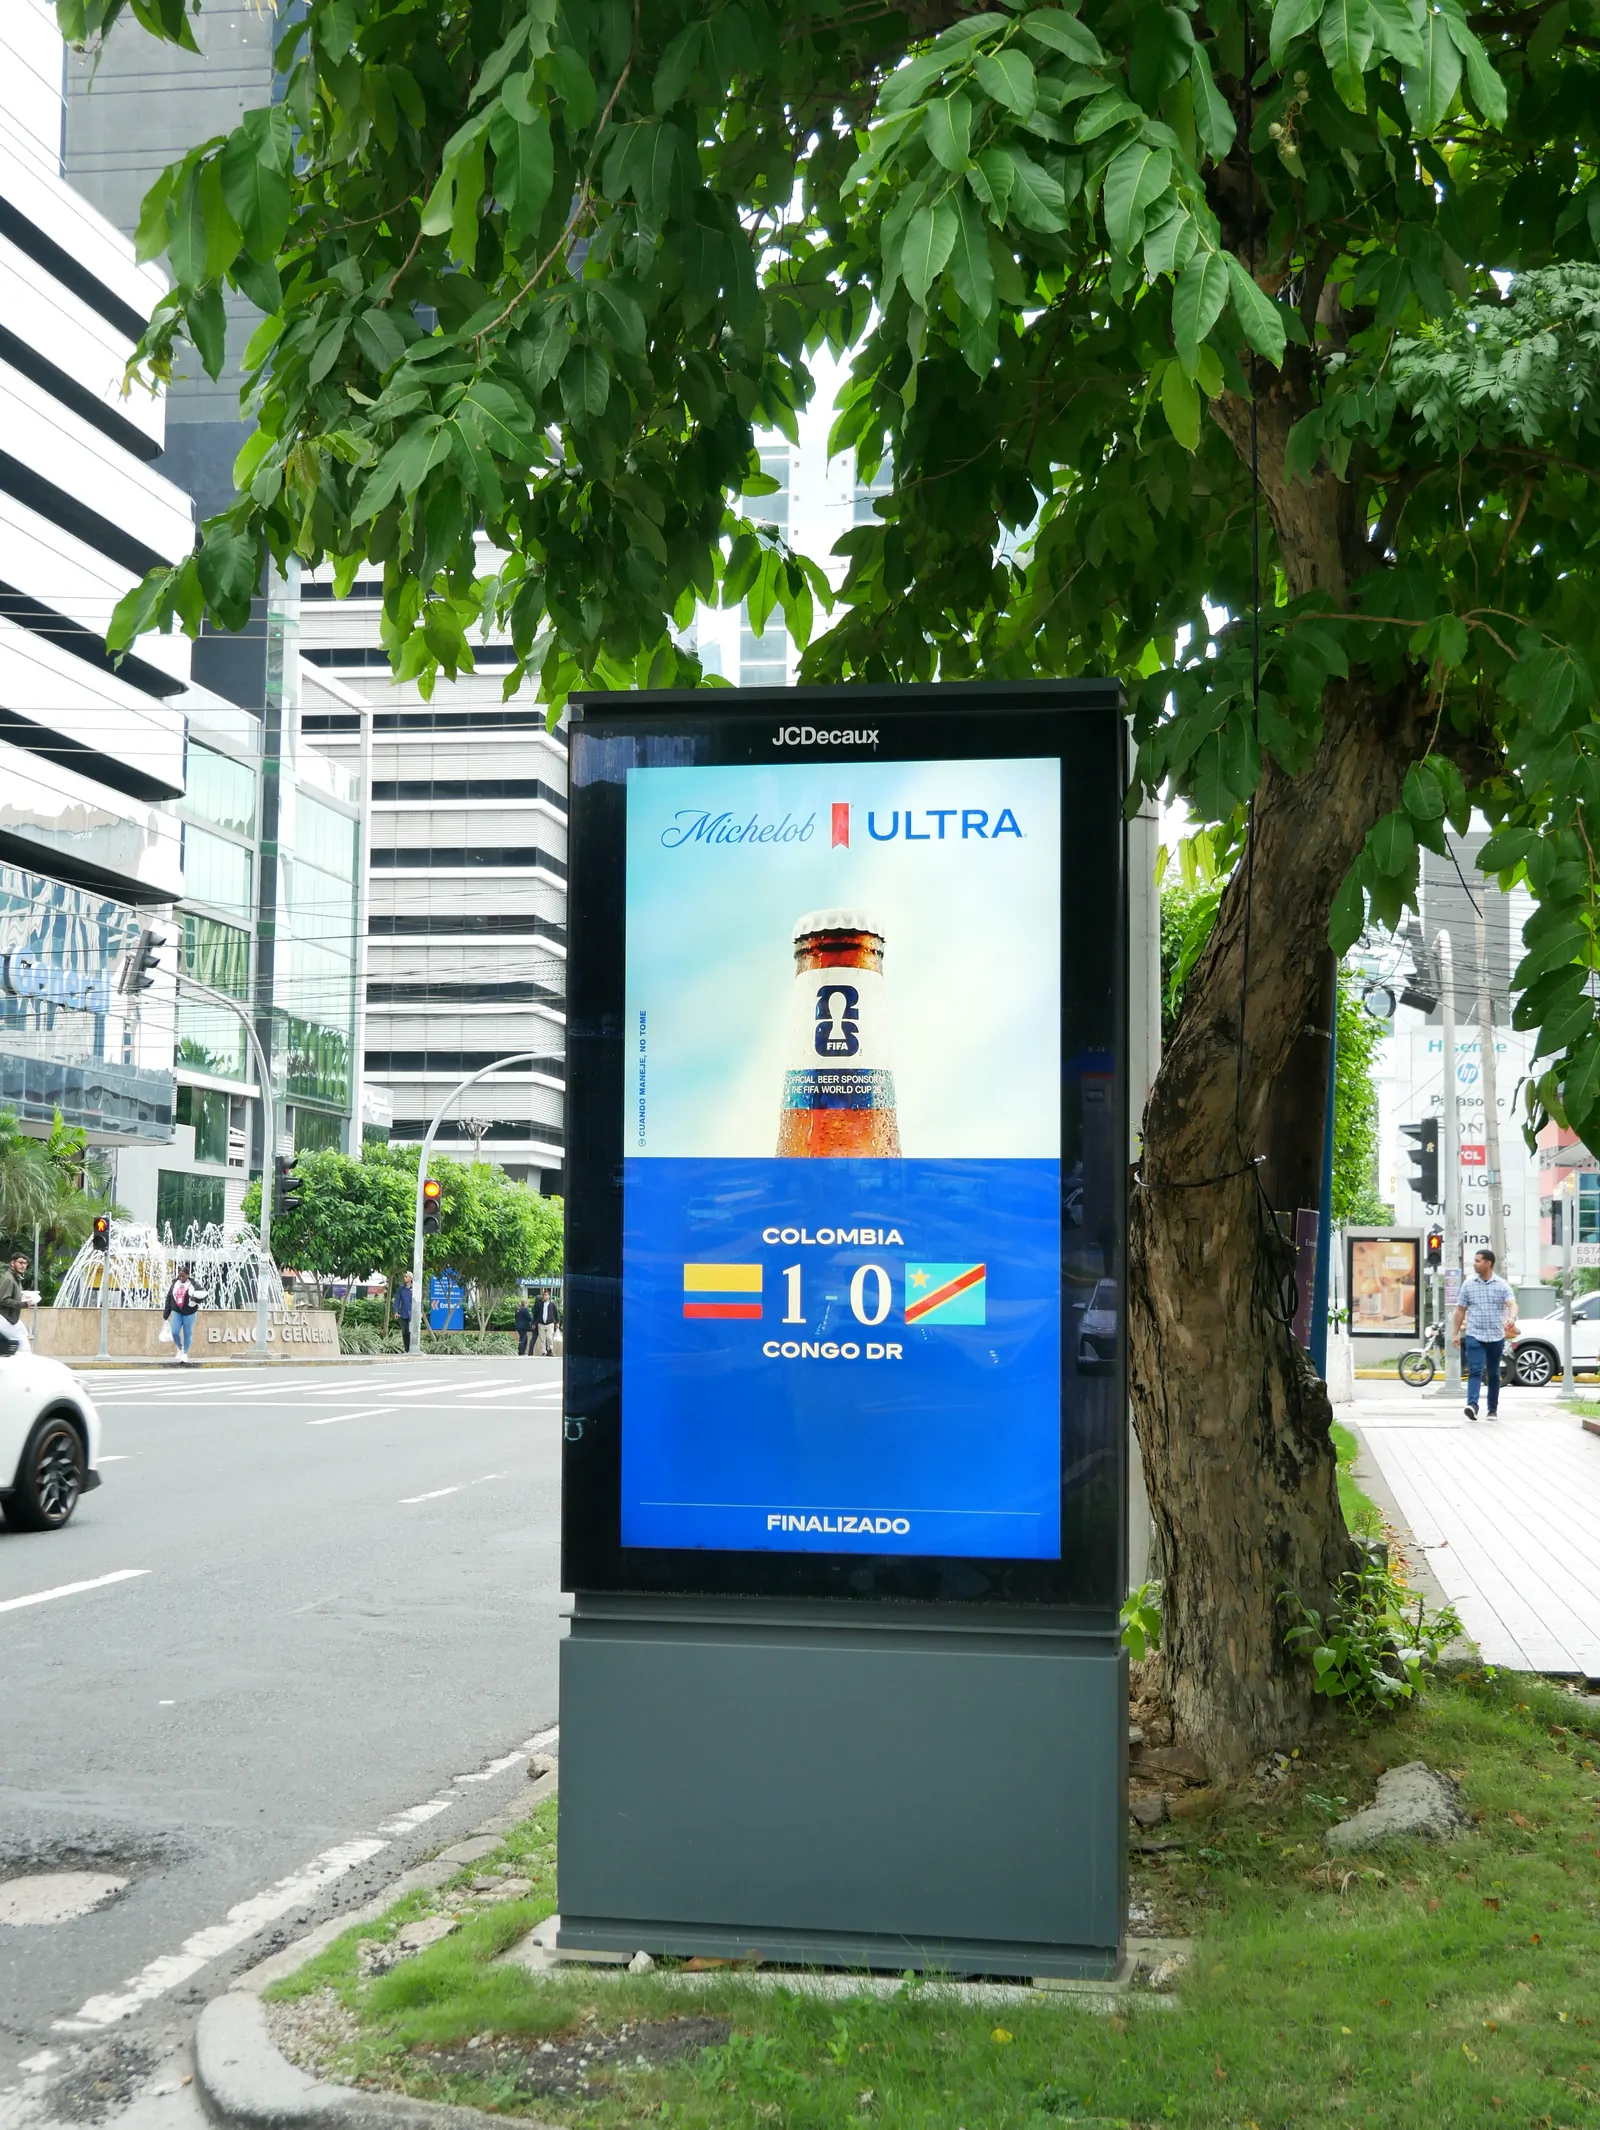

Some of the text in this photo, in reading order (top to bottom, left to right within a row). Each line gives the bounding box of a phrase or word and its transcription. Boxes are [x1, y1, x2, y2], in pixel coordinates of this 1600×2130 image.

[772, 726, 880, 746] JCDecaux
[660, 808, 1024, 848] Michelob ULTRA
[9, 945, 110, 1013] General
[639, 1038, 646, 1052] NO
[826, 1042, 849, 1051] FIFA
[639, 1055, 647, 1095] MANEJE,
[818, 1075, 839, 1084] BEER
[841, 1075, 879, 1084] SPONSOR
[803, 1086, 819, 1094] FIFA
[821, 1086, 854, 1094] WORLD
[855, 1086, 872, 1094] CUP
[638, 1098, 646, 1137] CUANDO
[762, 1228, 904, 1245] COLOMBIA
[782, 1264, 806, 1323] 1
[850, 1264, 892, 1326] 0
[762, 1341, 903, 1360] CONGO DR
[767, 1514, 911, 1535] FINALIZADO
